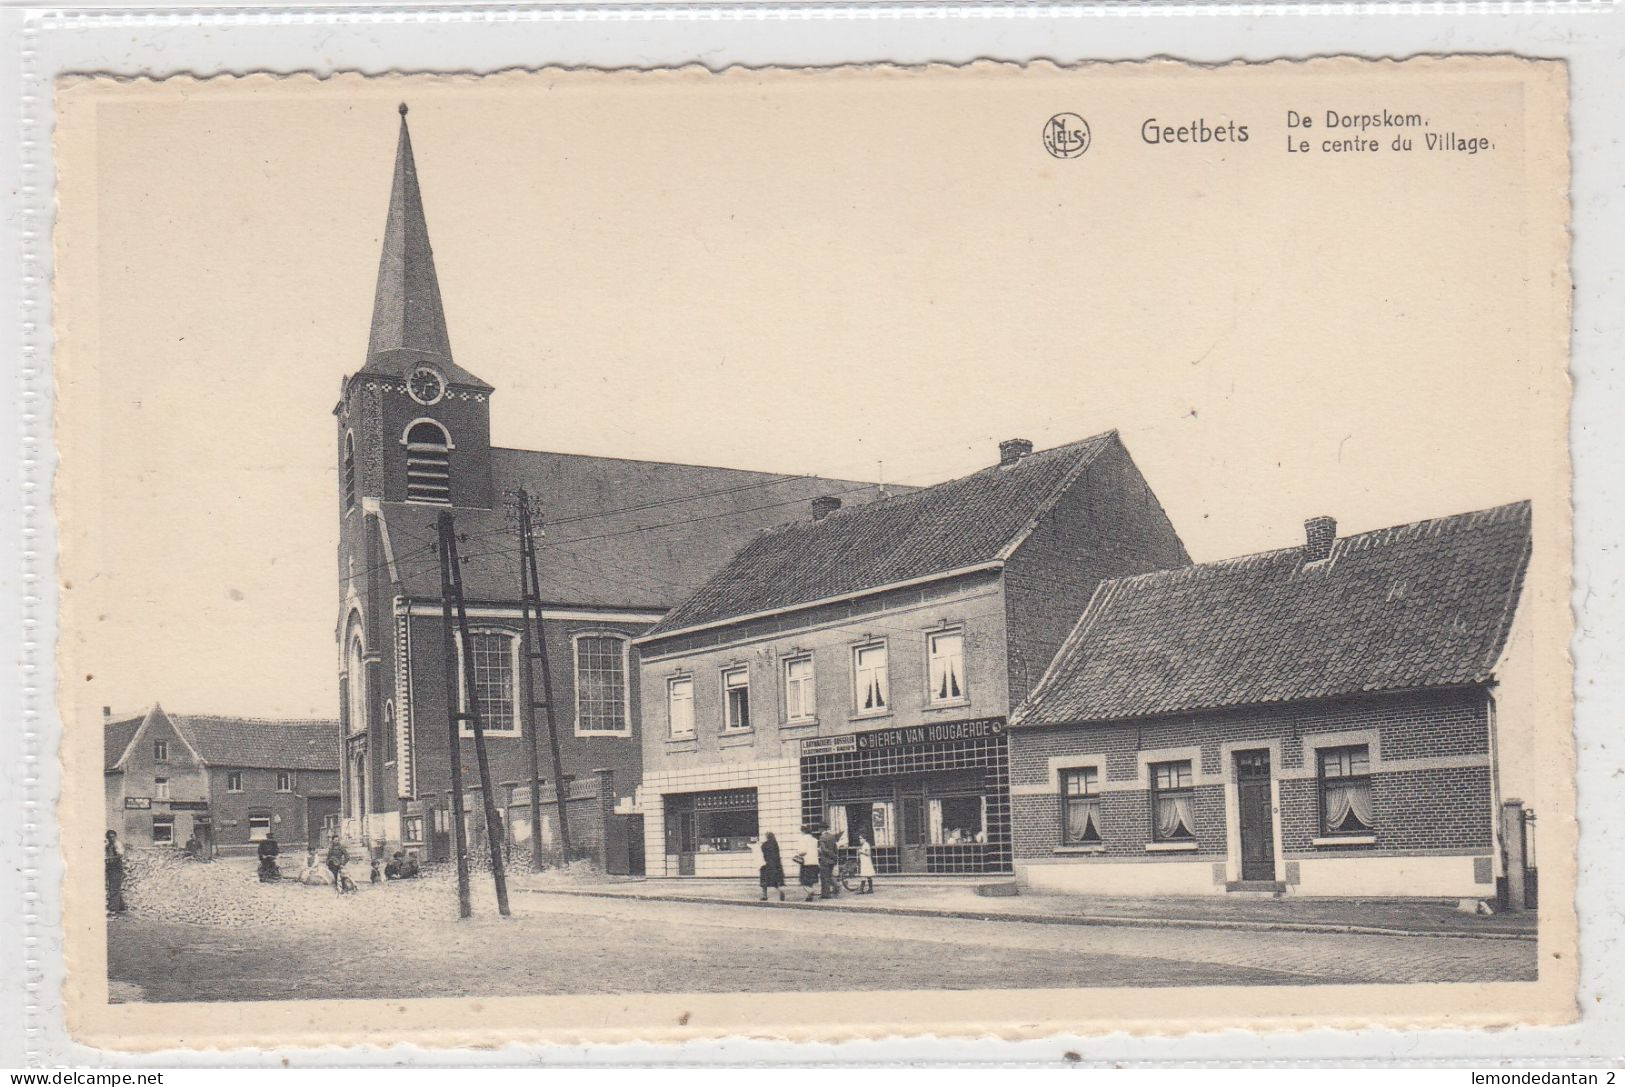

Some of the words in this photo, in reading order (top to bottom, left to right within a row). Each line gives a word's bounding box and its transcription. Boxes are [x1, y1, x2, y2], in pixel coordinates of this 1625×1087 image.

[869, 730, 903, 748] BIEREN
[906, 728, 925, 744] VAN
[929, 721, 990, 741] HOUGAERDE
